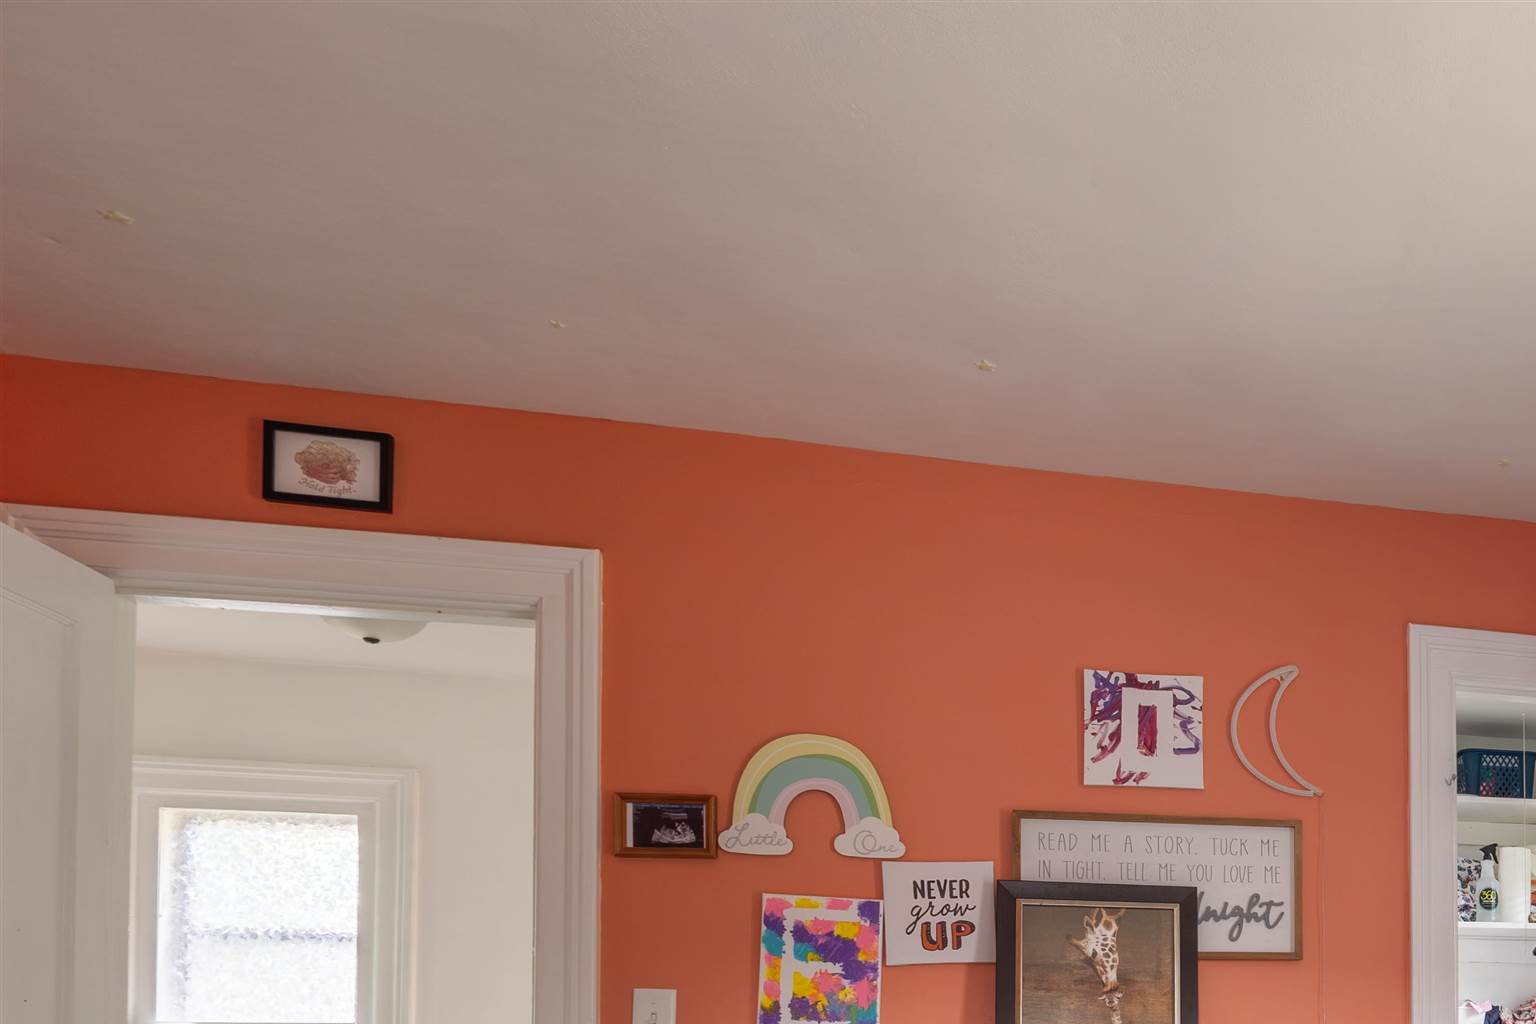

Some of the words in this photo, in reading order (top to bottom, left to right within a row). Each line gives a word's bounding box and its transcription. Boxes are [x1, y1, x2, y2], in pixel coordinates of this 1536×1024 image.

[725, 822, 789, 849] Little
[853, 829, 900, 855] One
[1037, 831, 1078, 852] READ
[1090, 832, 1111, 853] ME
[1124, 834, 1133, 854] A
[1145, 835, 1198, 856] STORY.
[1208, 837, 1249, 857] TUCK
[1260, 839, 1280, 857] ME
[1037, 860, 1051, 879] IN
[1063, 860, 1106, 880] TIGHT.
[1117, 862, 1145, 881] TELL
[1158, 863, 1178, 881] ME
[1186, 863, 1213, 882] YOU
[1223, 865, 1255, 883] LOVE
[1264, 866, 1281, 884] ME
[912, 878, 970, 900] NEVER
[905, 901, 977, 936] grow
[921, 919, 976, 952] UP
